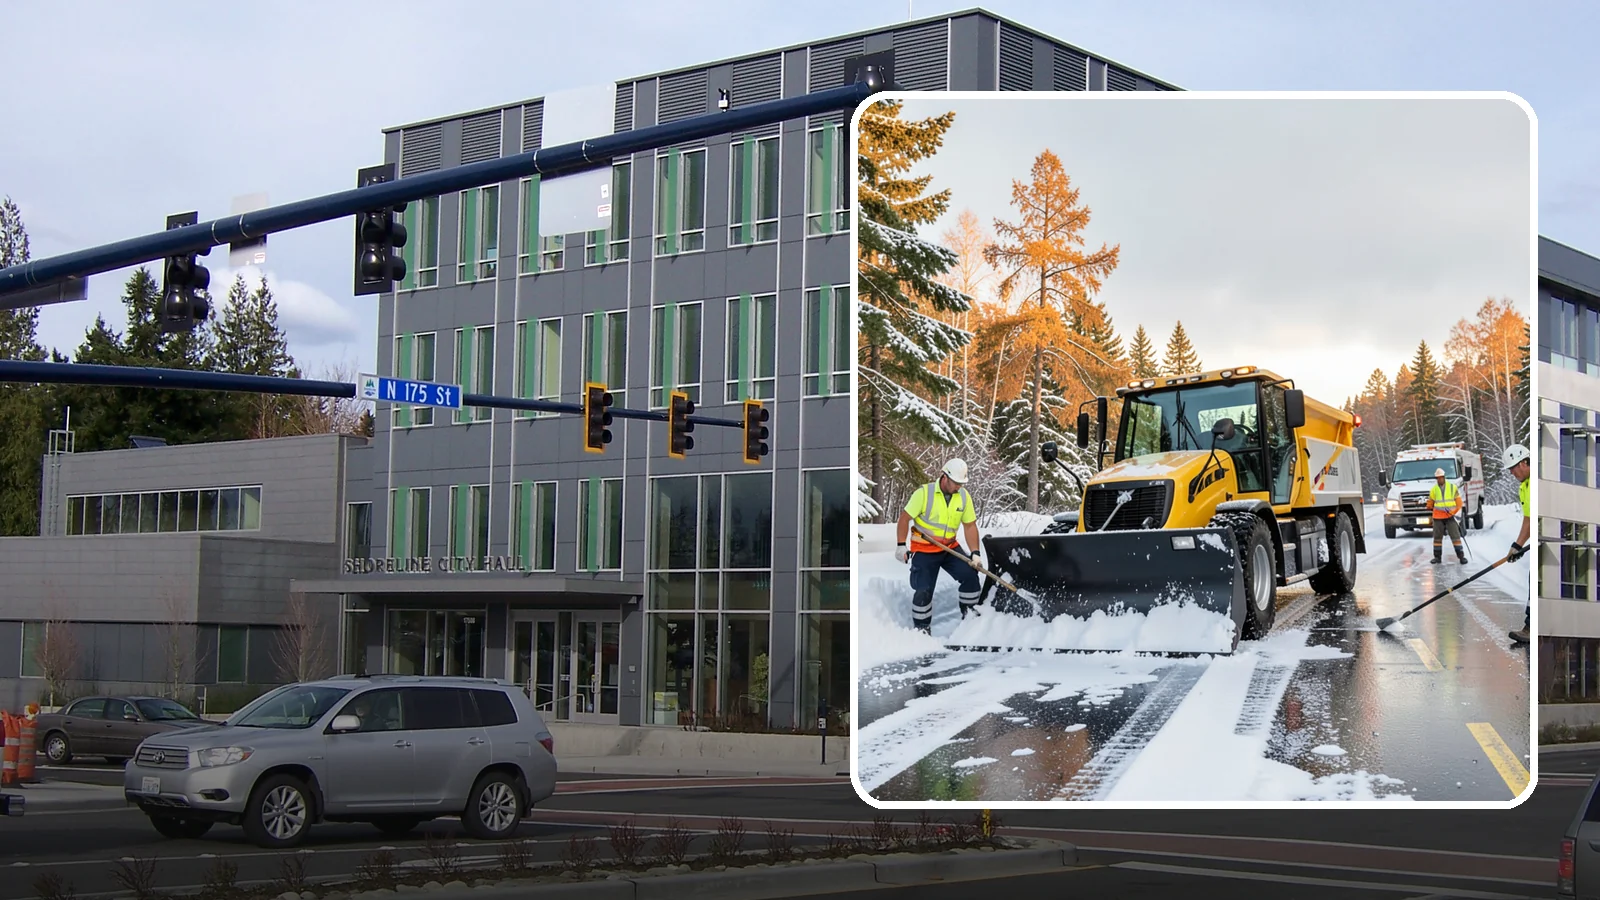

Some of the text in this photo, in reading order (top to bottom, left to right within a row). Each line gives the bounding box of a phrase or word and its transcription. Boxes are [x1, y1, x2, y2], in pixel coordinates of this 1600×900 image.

[387, 380, 451, 406] N 175 St
[343, 556, 526, 575] SHORELINE CITY HALL
